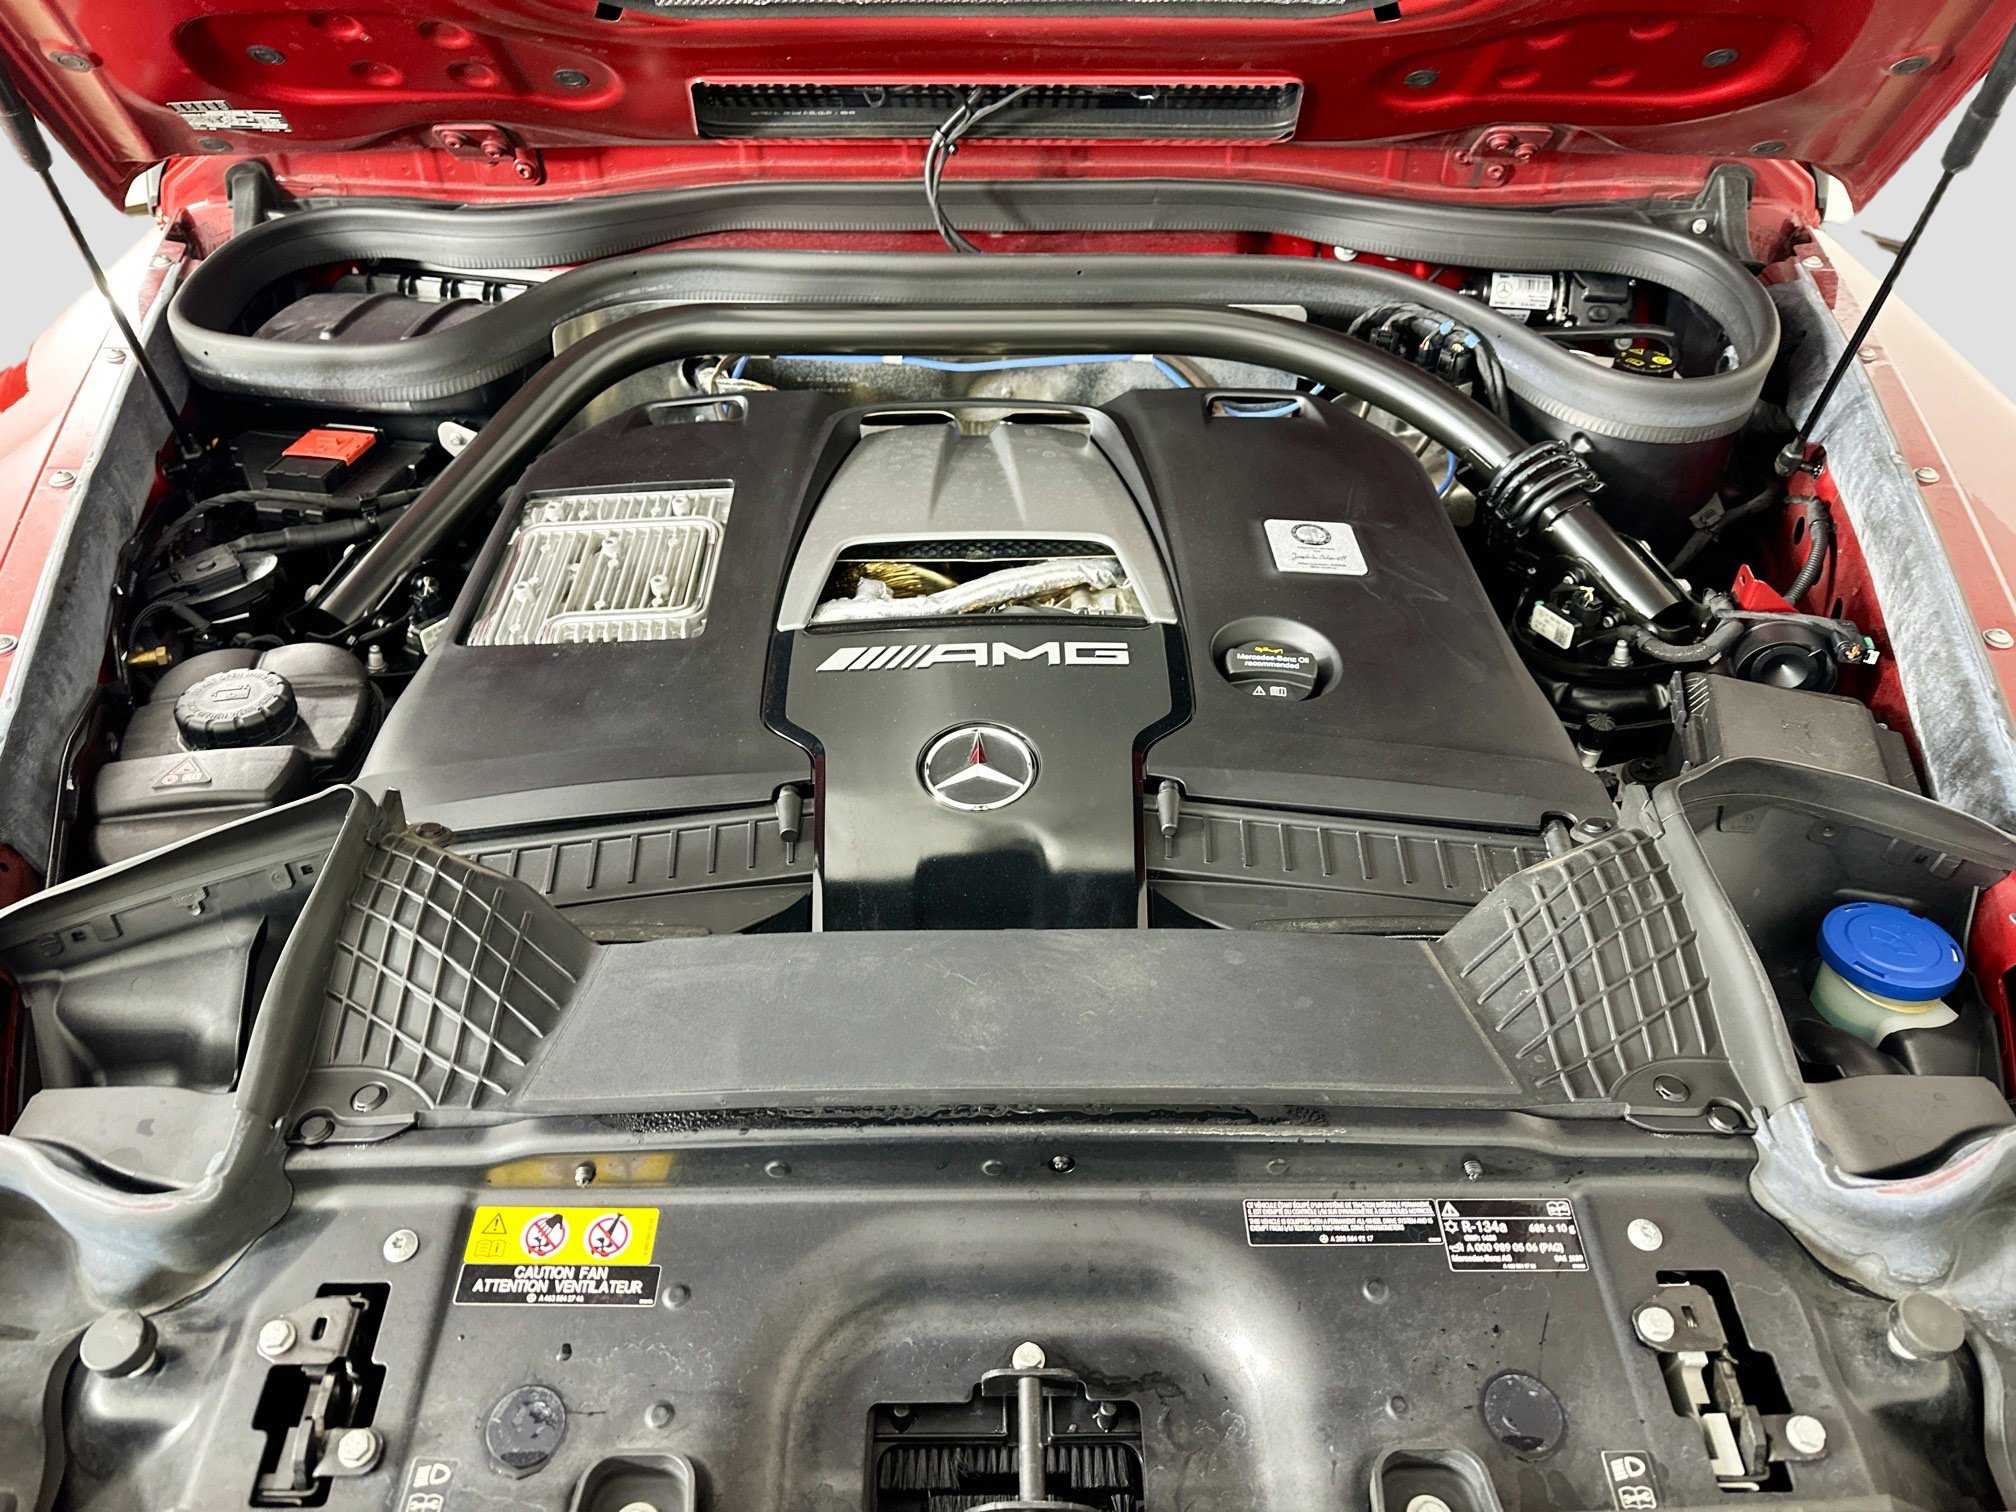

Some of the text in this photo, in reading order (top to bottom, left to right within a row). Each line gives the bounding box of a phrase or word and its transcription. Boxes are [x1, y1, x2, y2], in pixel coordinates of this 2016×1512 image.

[916, 641, 1130, 669] AMG
[1236, 652, 1297, 663] Mercedes-Benz
[1244, 660, 1300, 669] recommended
[1460, 1220, 1508, 1233] R-134a
[1555, 1223, 1567, 1233] 10
[1568, 1225, 1576, 1235] g
[1466, 1243, 1474, 1252] A
[1474, 1243, 1492, 1252] 000
[1512, 1243, 1524, 1252] 05
[1525, 1243, 1538, 1252] 06
[1539, 1243, 1564, 1254] (PAG)
[1451, 1254, 1501, 1262] Mercedes-Benz
[514, 1266, 609, 1280] CAUTION FAN
[472, 1279, 644, 1294] ATTENTION VENTILATEUR
